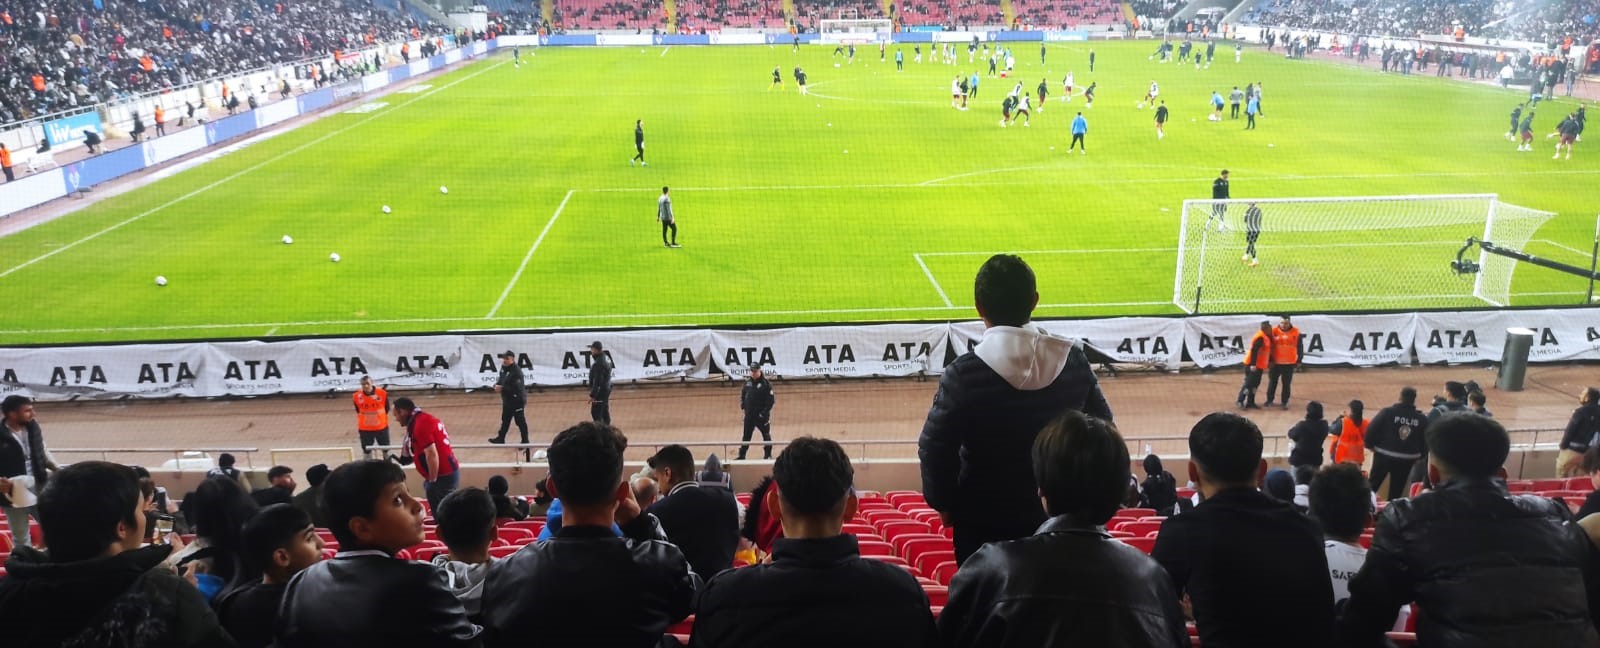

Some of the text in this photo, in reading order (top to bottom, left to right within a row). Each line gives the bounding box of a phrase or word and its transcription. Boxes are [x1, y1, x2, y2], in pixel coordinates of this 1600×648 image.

[1116, 336, 1168, 355] ATA
[1199, 332, 1245, 352] ATA
[1349, 331, 1403, 351] ATA
[1427, 329, 1478, 348] ATA
[396, 355, 449, 372] ATA
[479, 352, 534, 373] AA
[643, 347, 697, 367] ATA
[725, 346, 776, 366] ATA
[803, 344, 855, 364] ATA
[49, 365, 107, 387] ATA
[137, 362, 196, 383] ATA
[224, 360, 282, 380] ATA
[311, 356, 368, 377] ATA
